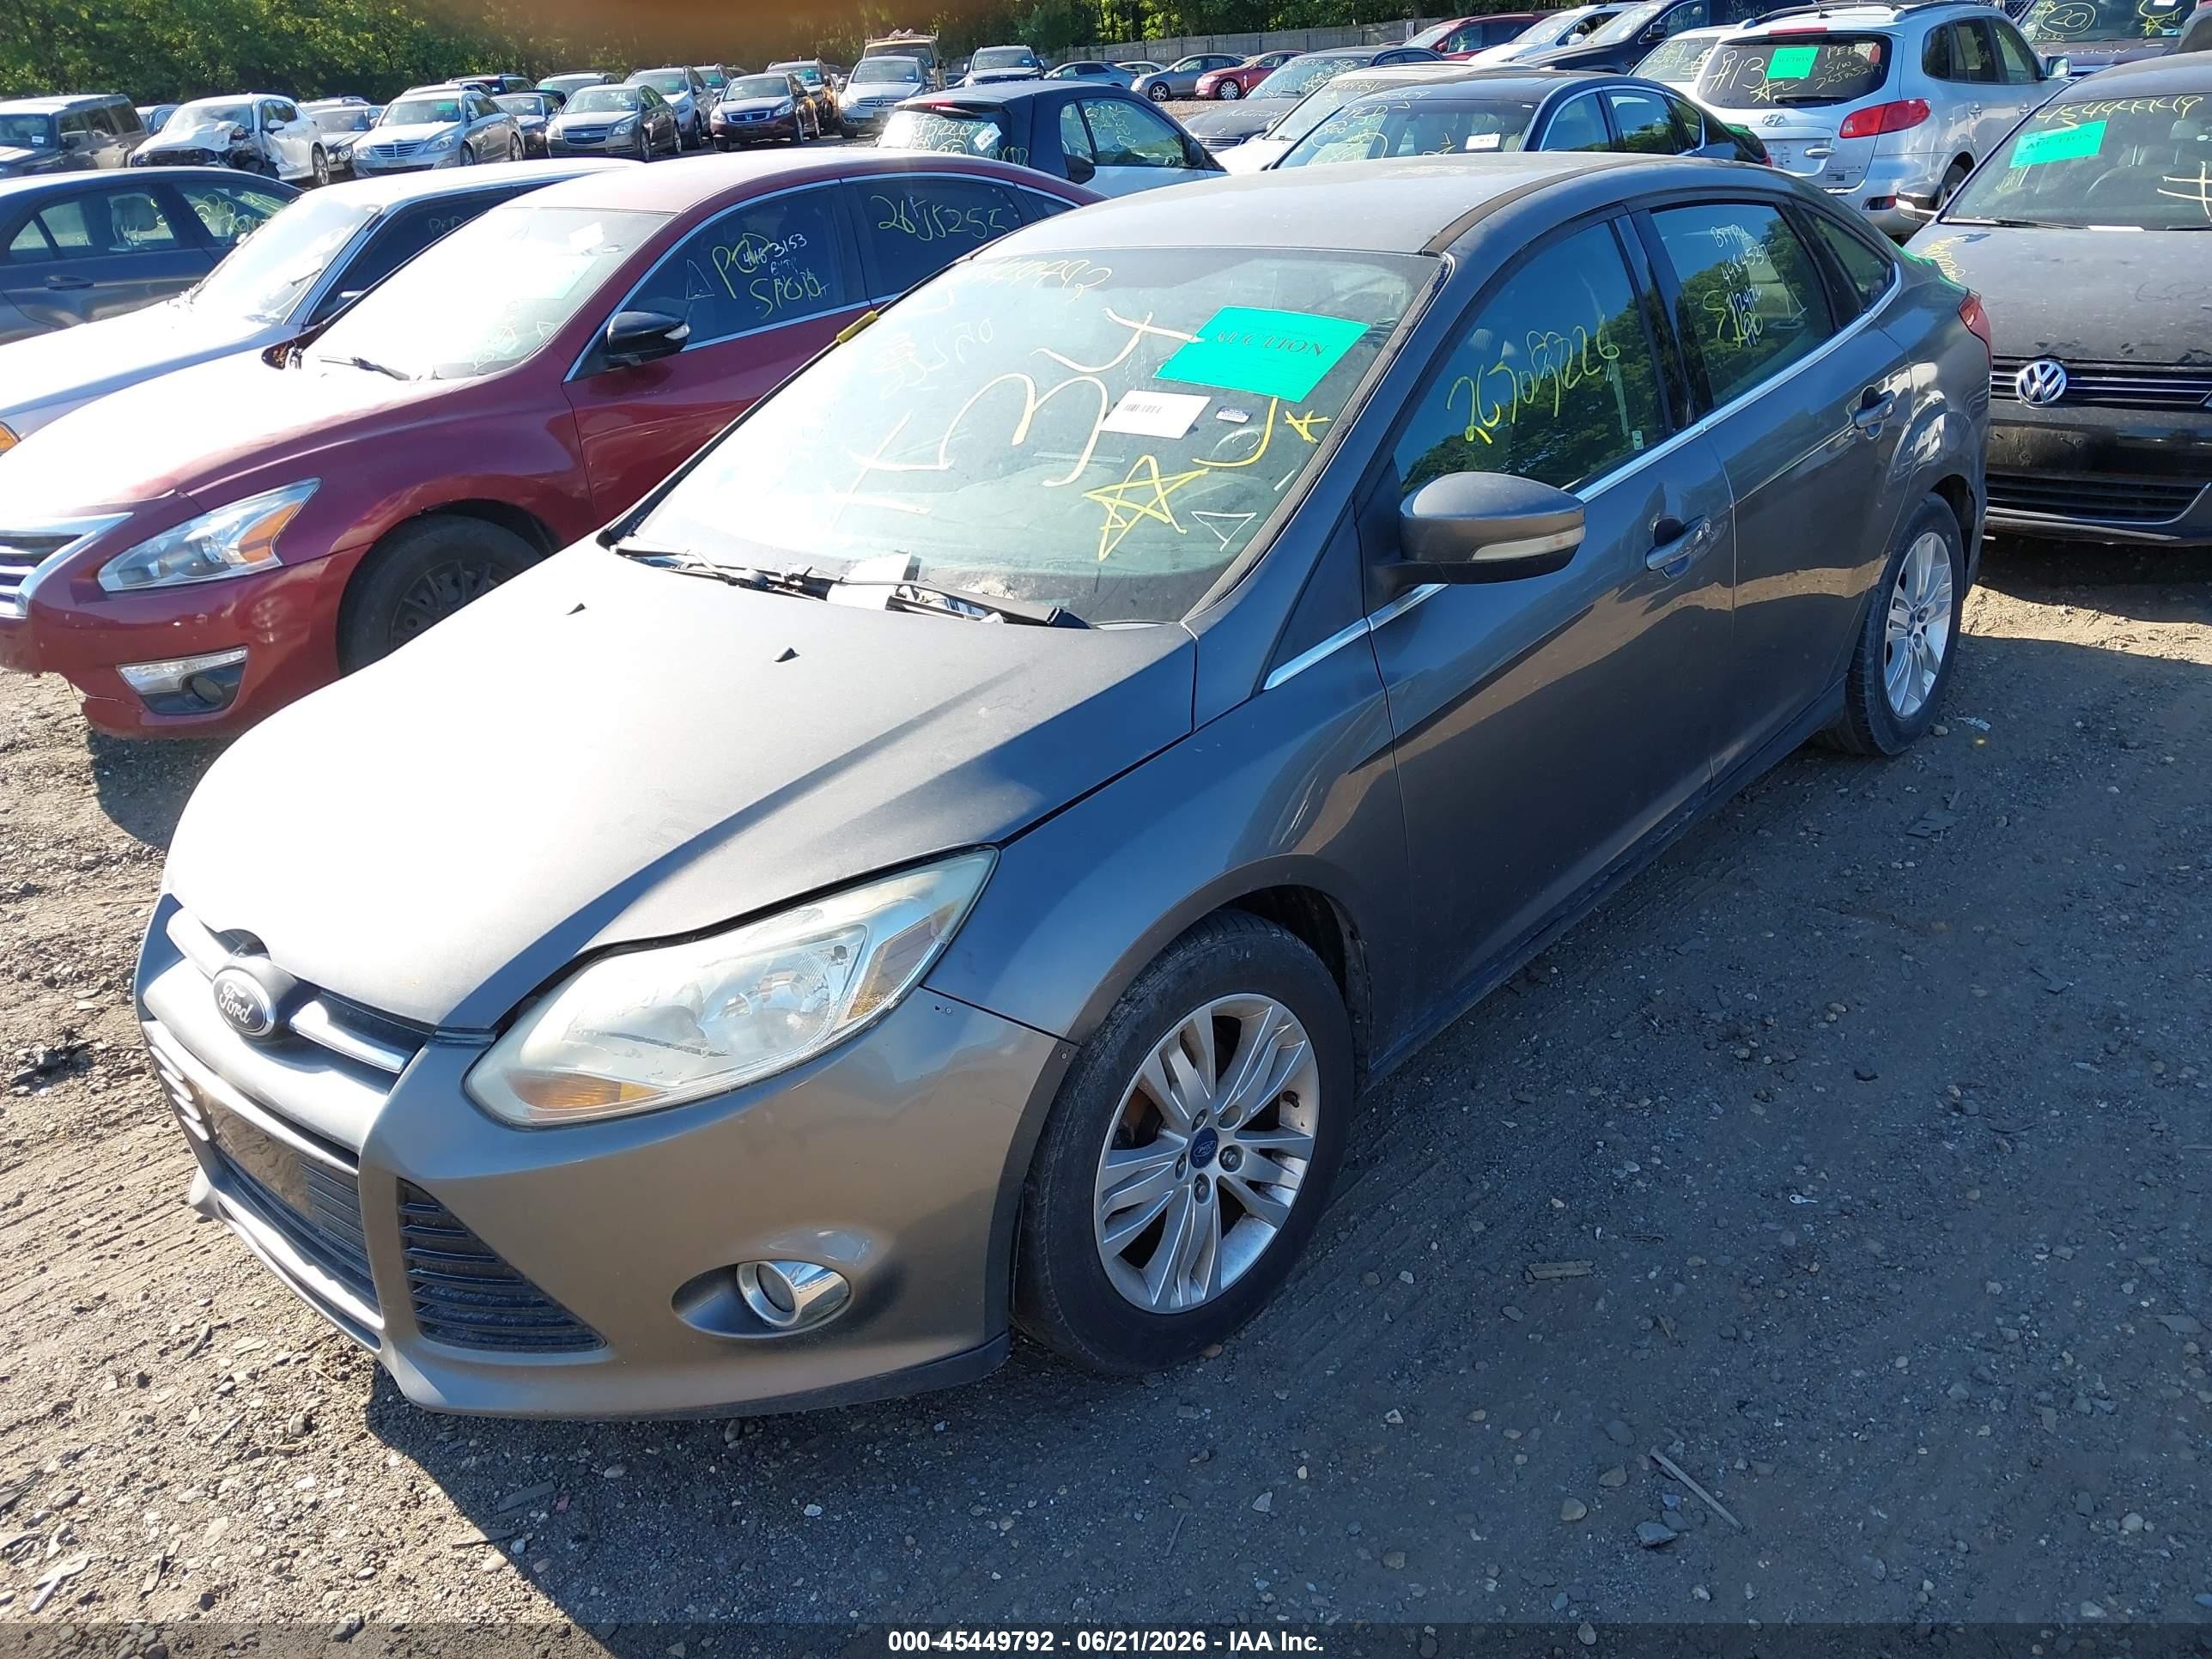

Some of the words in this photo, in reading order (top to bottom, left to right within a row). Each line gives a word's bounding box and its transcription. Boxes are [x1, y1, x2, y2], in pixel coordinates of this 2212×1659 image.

[2049, 9, 2087, 27] 20
[1212, 330, 1331, 357] AUCTION
[218, 981, 255, 1024] Ford
